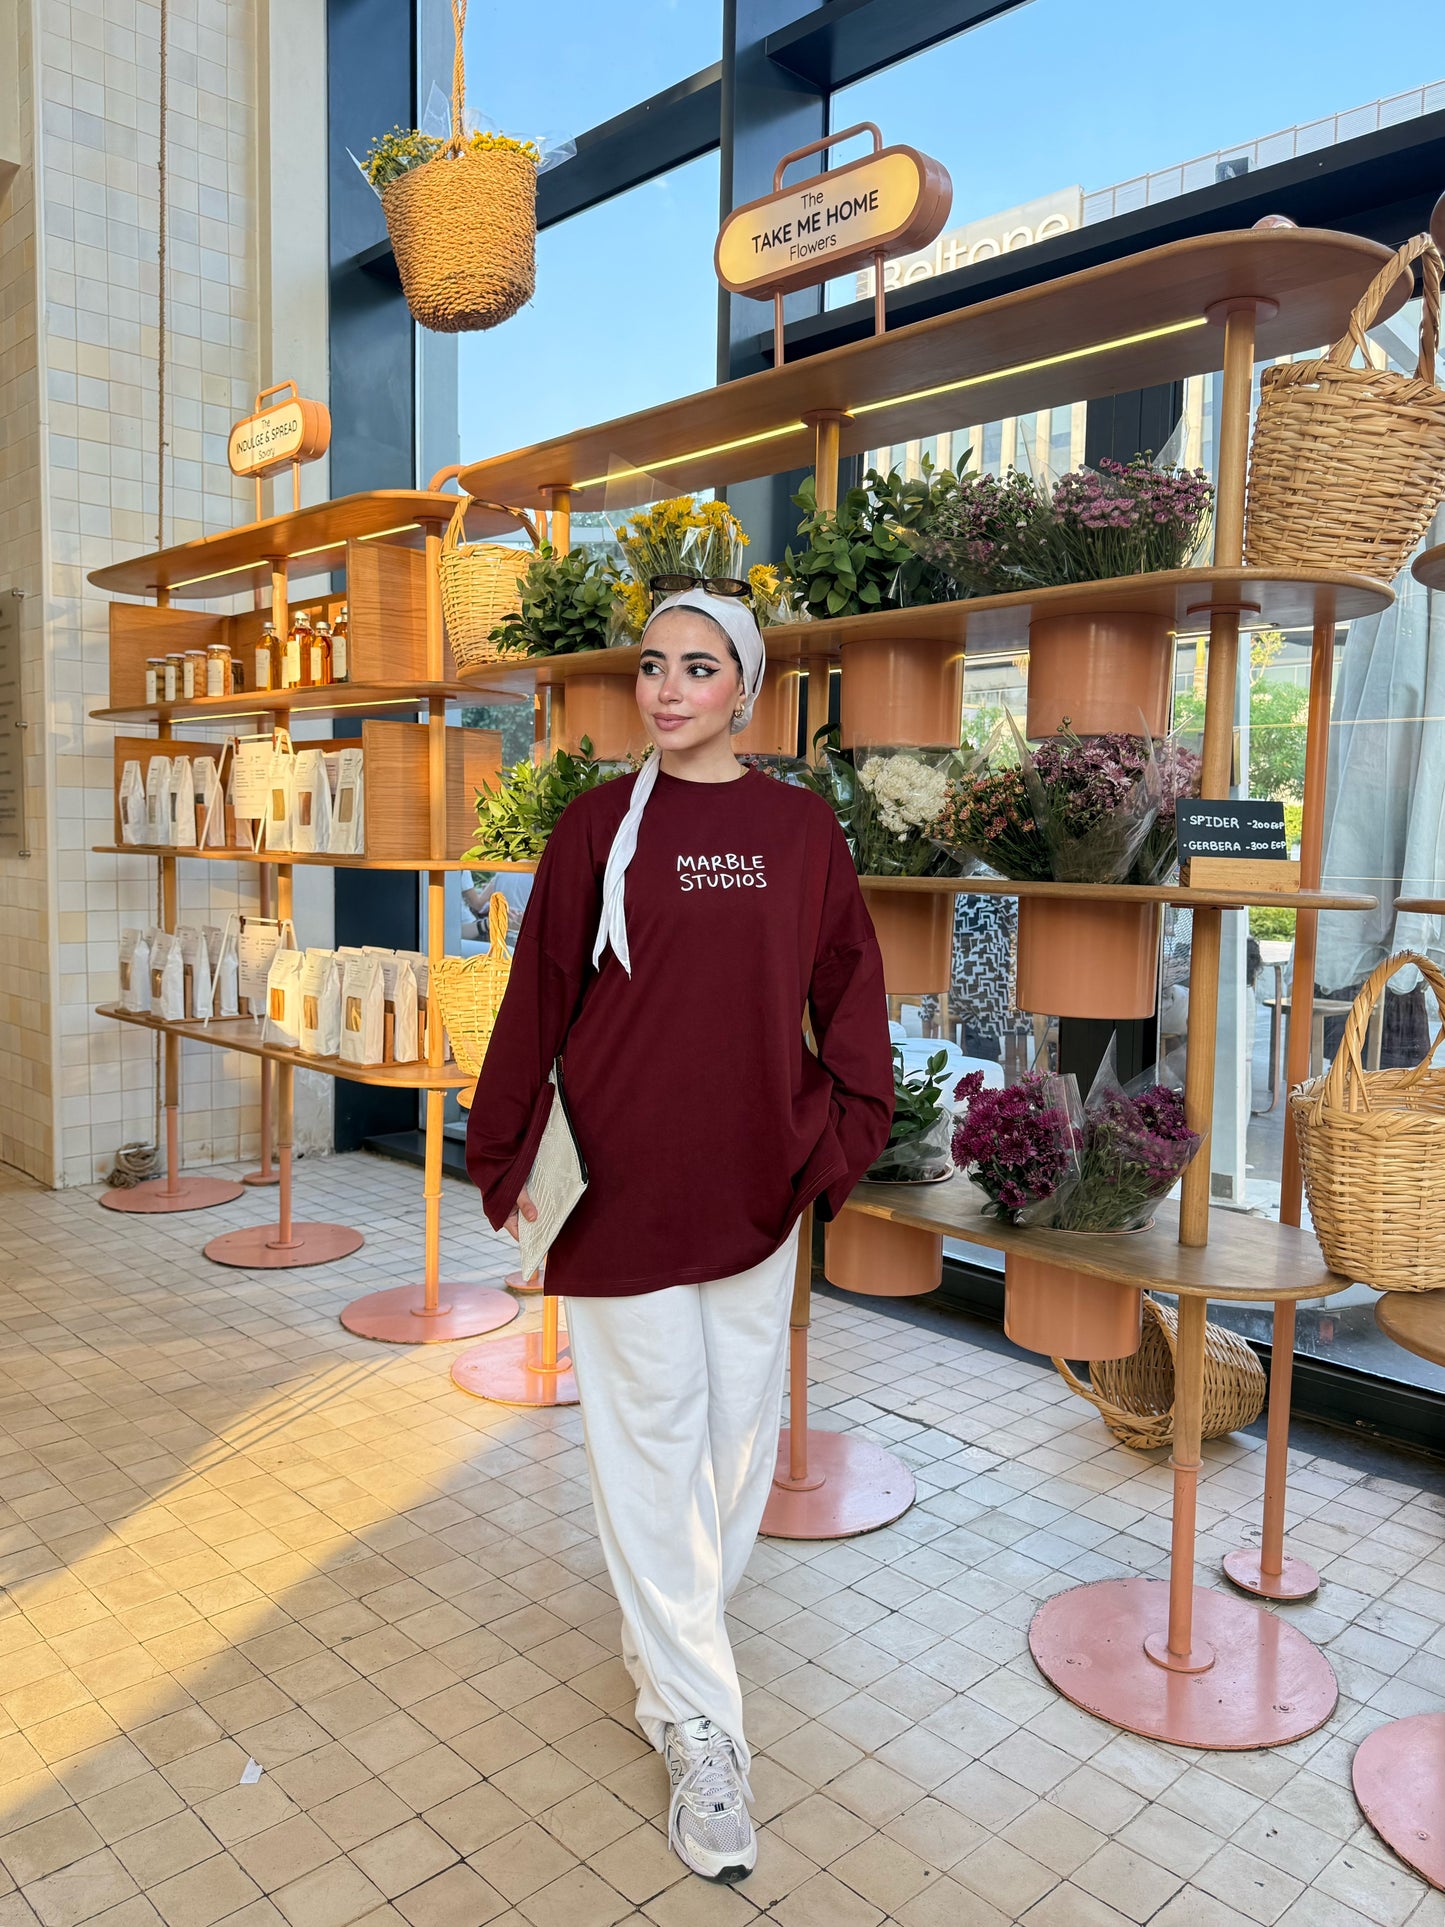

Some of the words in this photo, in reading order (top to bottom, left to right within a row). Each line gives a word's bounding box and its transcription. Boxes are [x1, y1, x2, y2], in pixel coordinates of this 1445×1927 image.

[801, 191, 824, 210] The
[752, 223, 792, 254] TAKE
[797, 212, 821, 238] ME
[827, 189, 879, 226] HOME
[789, 233, 837, 261] Flowers
[261, 419, 271, 429] The
[236, 433, 264, 455] INDULGE
[265, 431, 270, 443] &
[271, 420, 298, 441] SPREAD
[1189, 815, 1240, 829] SPIDER
[1188, 841, 1241, 851] GERBERA
[676, 853, 766, 872] MARBLE
[679, 872, 768, 892] STUDIOS
